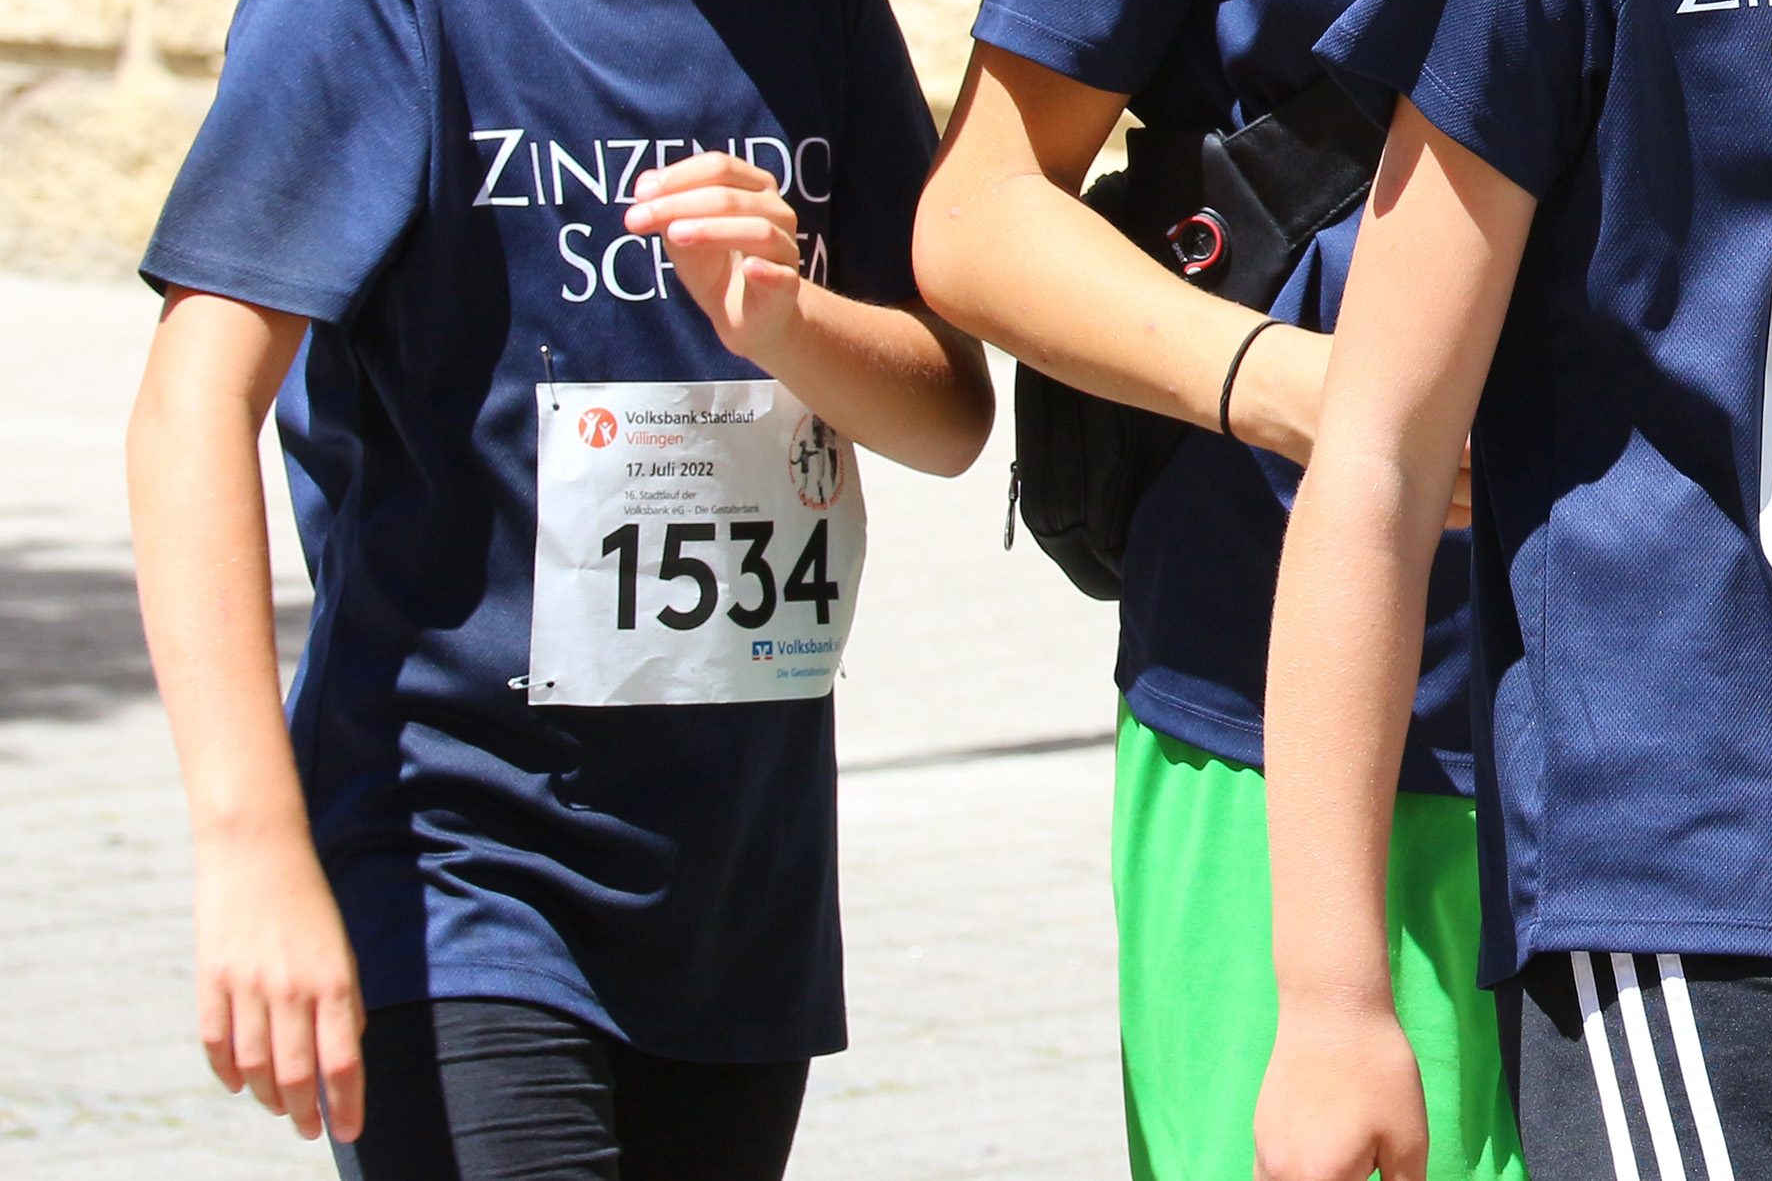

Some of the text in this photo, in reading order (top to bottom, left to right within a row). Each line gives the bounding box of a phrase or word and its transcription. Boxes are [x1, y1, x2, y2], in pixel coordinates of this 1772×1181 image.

[625, 409, 754, 425] Volksbank Stadtlauf
[625, 431, 684, 449] Villingen
[626, 462, 714, 477] 17. Juli 2022
[639, 490, 679, 500] Stadtlauf
[682, 490, 697, 500] der
[623, 506, 669, 515] Volksbank
[601, 518, 840, 631] 1534
